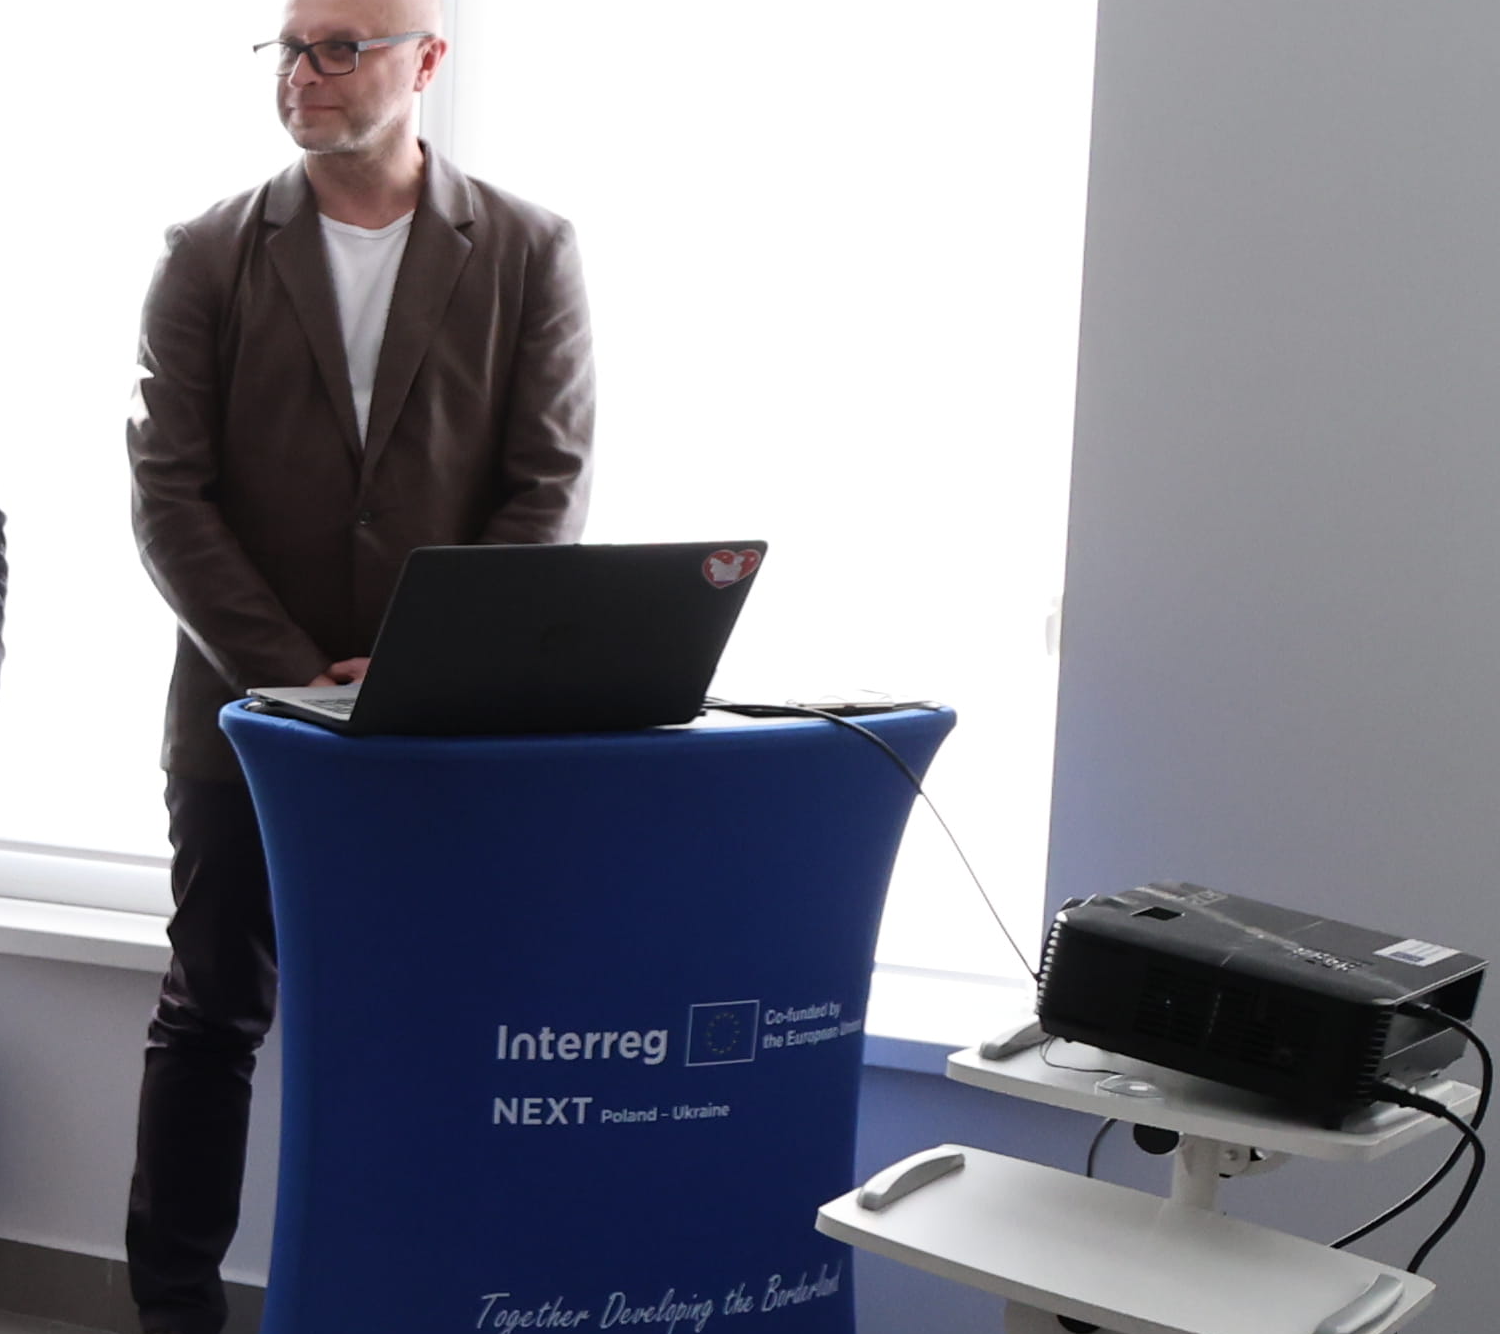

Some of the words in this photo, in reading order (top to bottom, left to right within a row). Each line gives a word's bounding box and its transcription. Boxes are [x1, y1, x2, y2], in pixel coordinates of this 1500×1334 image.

[765, 1003, 828, 1024] Co-funded
[497, 1025, 668, 1065] Interreg
[762, 1033, 784, 1049] the
[493, 1097, 592, 1125] NEXT
[602, 1107, 657, 1124] Poland
[673, 1103, 730, 1120] Ukraine
[600, 1288, 714, 1334] Developing
[724, 1283, 753, 1313] the
